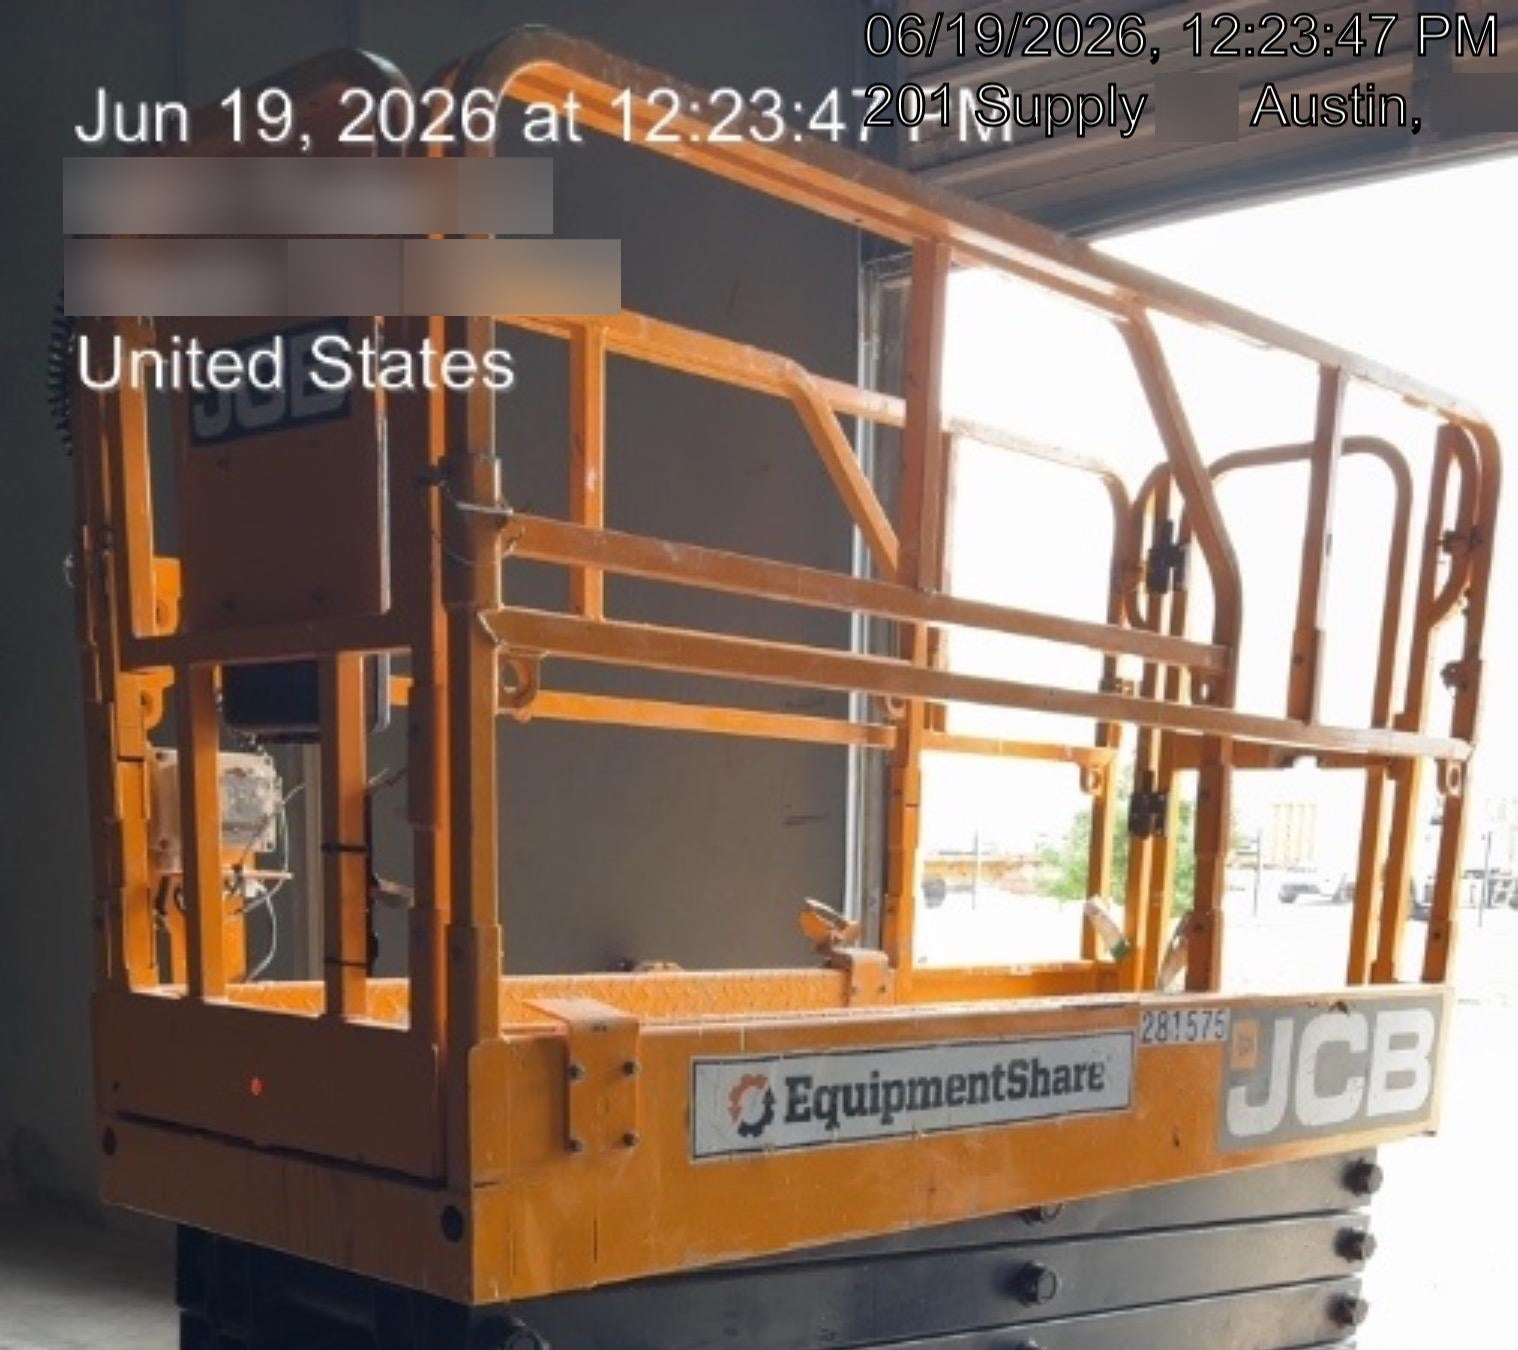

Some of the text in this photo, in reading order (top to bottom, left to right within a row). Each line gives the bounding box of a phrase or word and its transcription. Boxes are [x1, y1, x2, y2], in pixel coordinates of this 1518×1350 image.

[1142, 1008, 1226, 1043] 281575
[784, 1056, 1105, 1132] EquipmentShare
[1226, 1008, 1434, 1136] JCB
